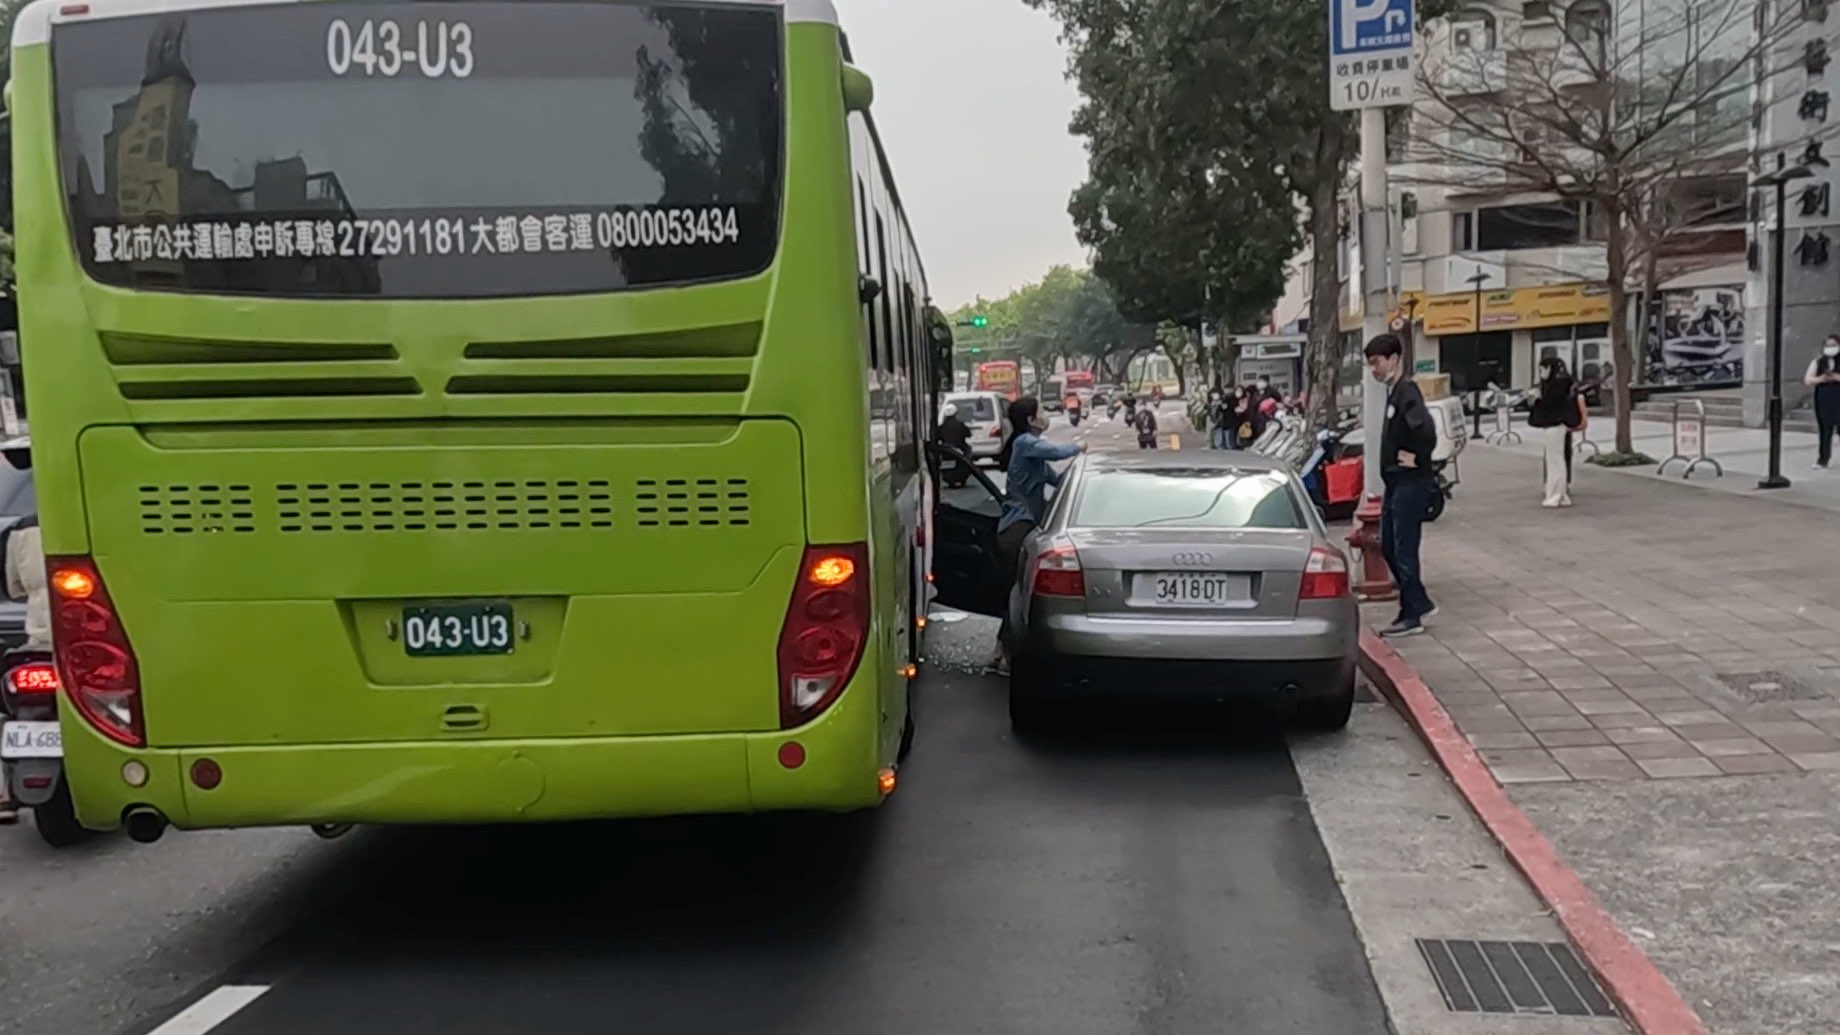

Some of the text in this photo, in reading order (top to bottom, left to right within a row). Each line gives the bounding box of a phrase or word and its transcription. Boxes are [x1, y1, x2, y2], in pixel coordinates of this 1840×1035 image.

[1341, 0, 1390, 50] P
[326, 19, 474, 78] 043-U3
[598, 207, 739, 248] 0800053434
[406, 614, 509, 649] 043-U3
